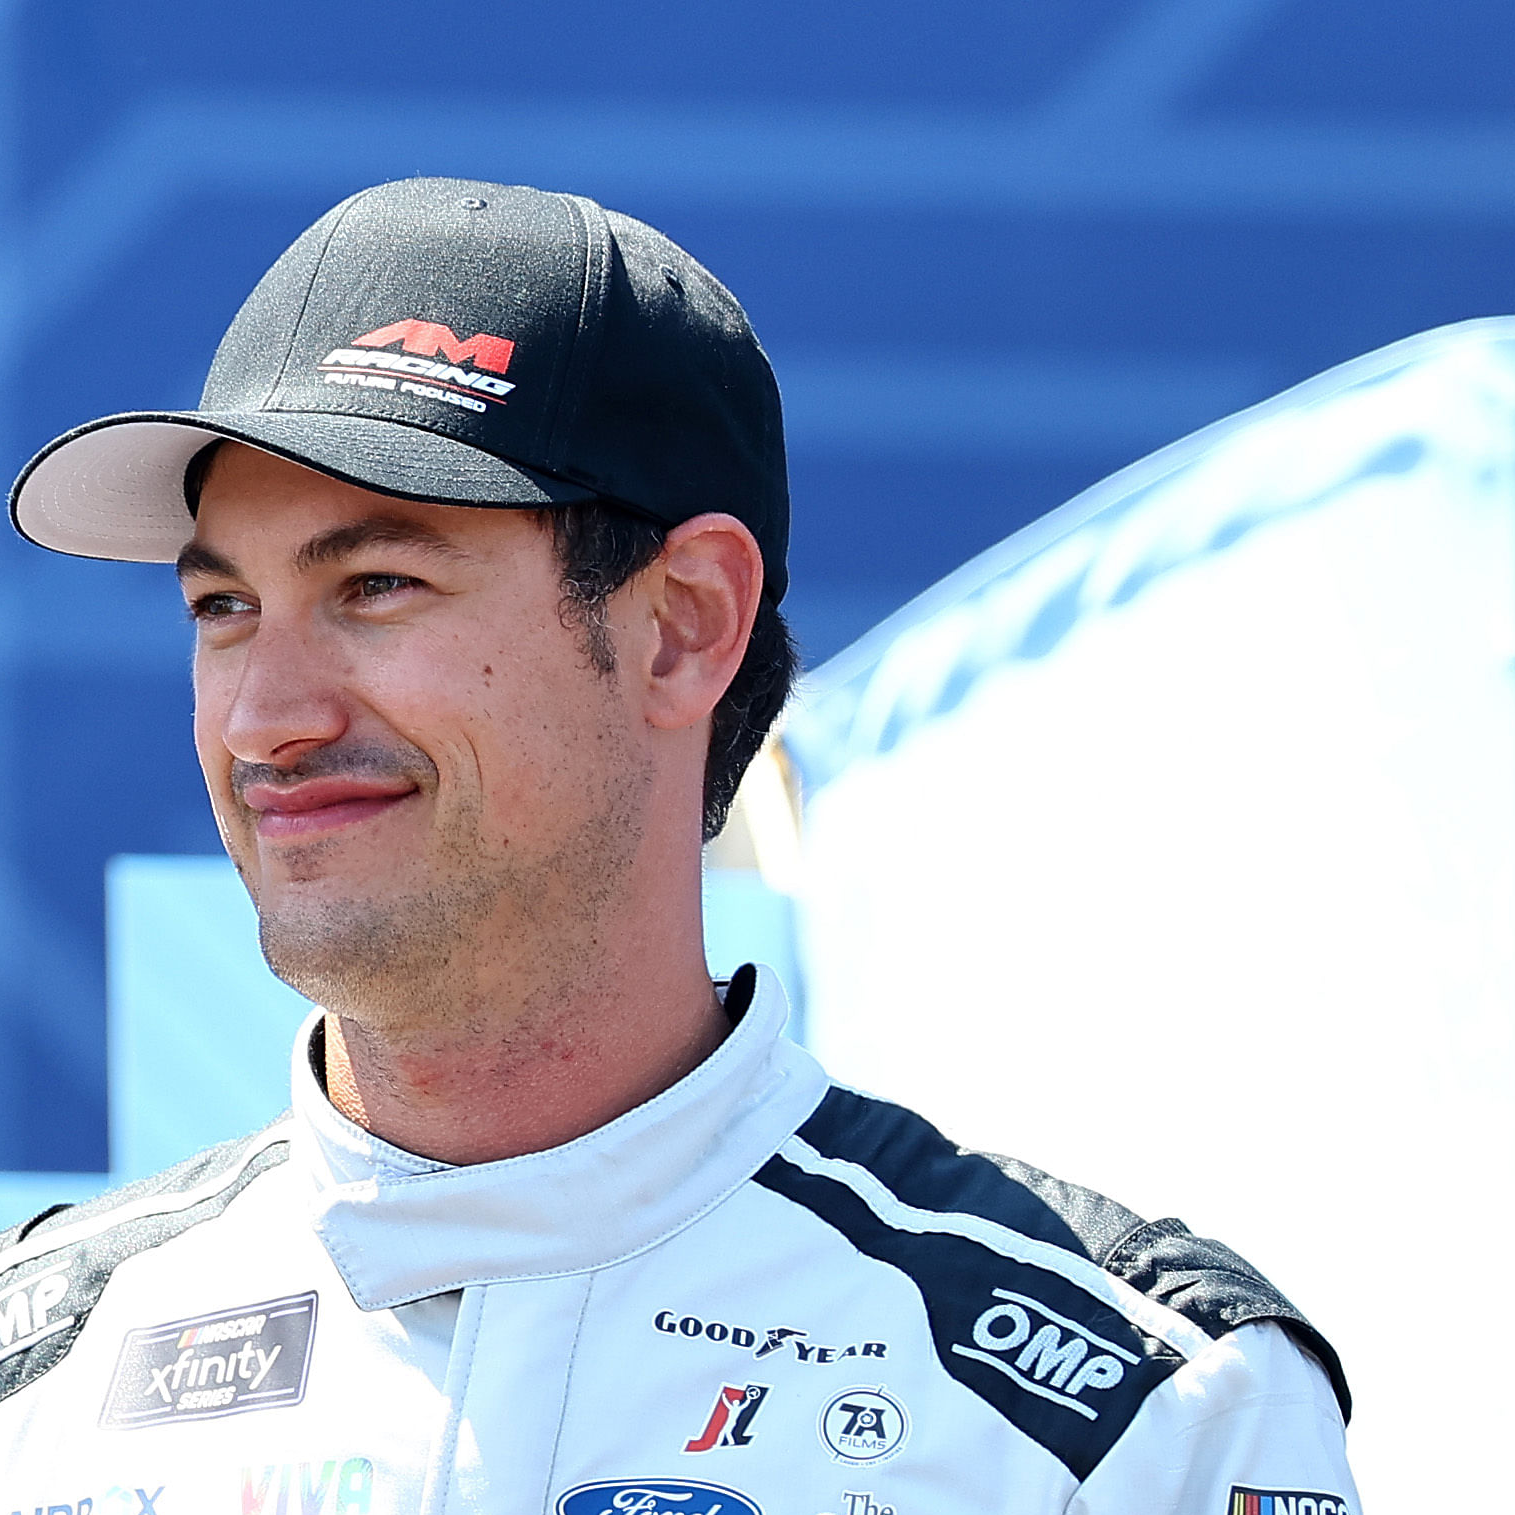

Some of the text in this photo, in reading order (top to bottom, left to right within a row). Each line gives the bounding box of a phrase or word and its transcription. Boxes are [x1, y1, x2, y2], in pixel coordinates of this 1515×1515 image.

[351, 318, 515, 374] AM
[322, 349, 516, 396] RACING
[400, 382, 487, 413] FOCUSED
[198, 1314, 266, 1343] NASCAR
[972, 1303, 1125, 1395] OMP
[143, 1340, 282, 1403] xfinity
[177, 1386, 236, 1410] SERIES
[838, 1436, 887, 1450] FILMS
